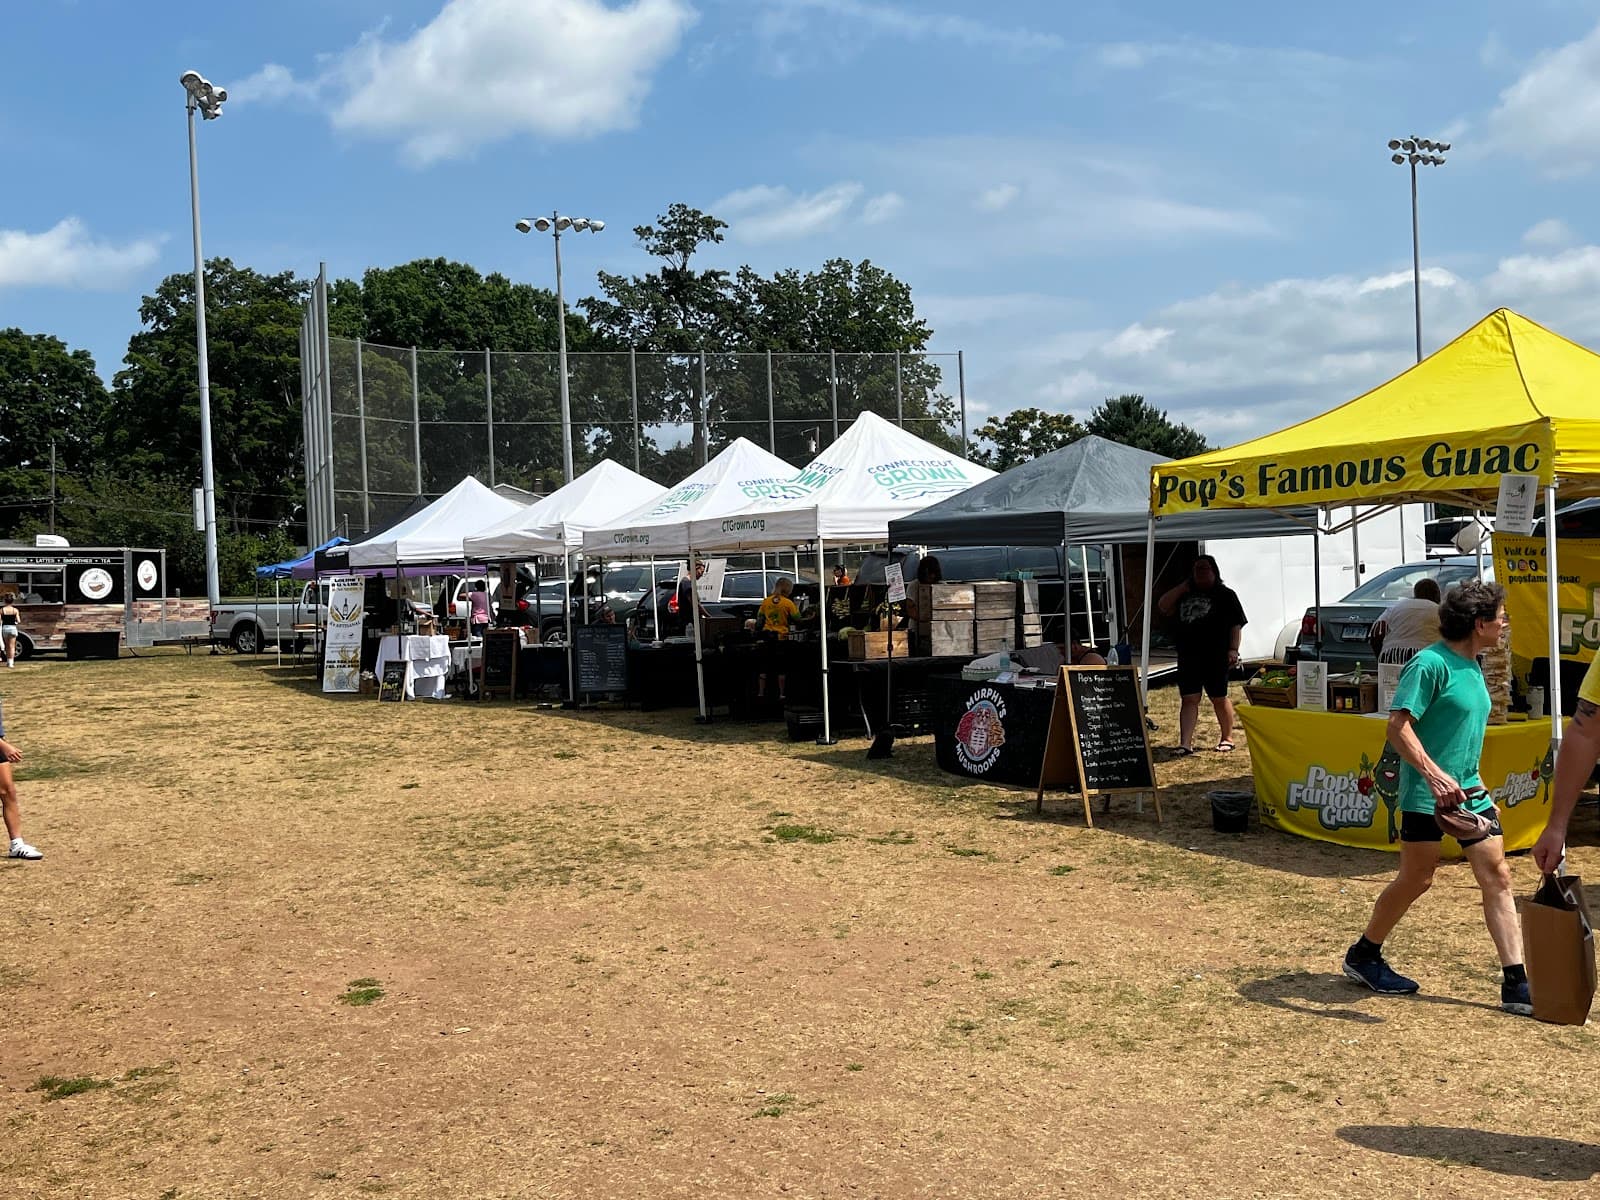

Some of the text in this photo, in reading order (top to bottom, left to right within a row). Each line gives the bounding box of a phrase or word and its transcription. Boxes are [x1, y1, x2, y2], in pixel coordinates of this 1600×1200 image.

[867, 459, 954, 475] CONNECTICUT
[873, 466, 969, 487] GROWN
[1158, 441, 1541, 509] Pop's Famous Guac
[721, 517, 766, 534] CTGrown.org
[613, 532, 650, 546] CTGrown.org
[1524, 547, 1537, 557] Us
[965, 687, 1007, 718] MURPHY'S
[955, 742, 1001, 775] MUSHROOMS
[1307, 765, 1359, 793] Pop's
[1289, 783, 1375, 809] Famous
[1320, 804, 1371, 826] Guac
